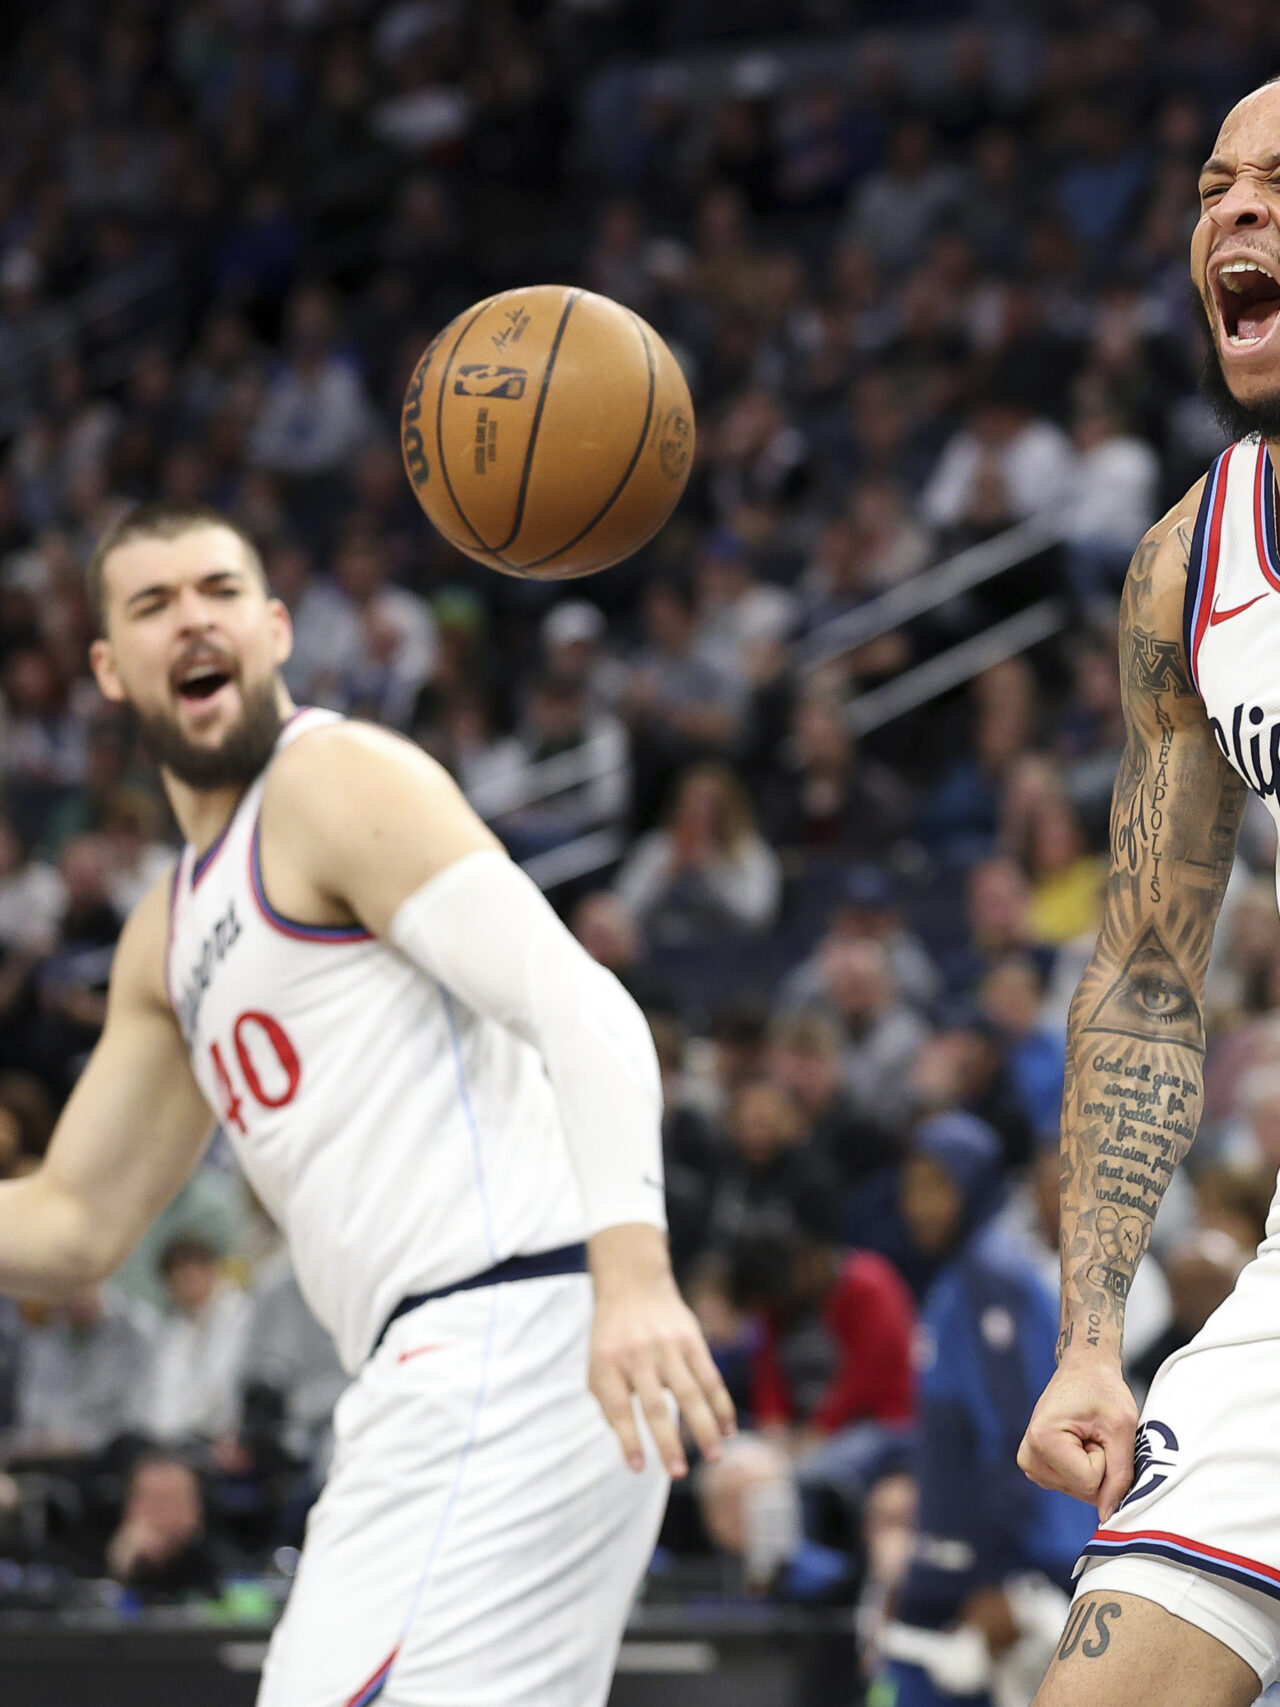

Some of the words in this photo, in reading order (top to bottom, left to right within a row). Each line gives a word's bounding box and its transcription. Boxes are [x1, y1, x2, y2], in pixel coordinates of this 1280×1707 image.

[210, 1010, 302, 1134] 40
[1093, 1055, 1122, 1074] God
[1124, 1064, 1151, 1082] will
[1153, 1072, 1180, 1090] give
[1104, 1083, 1162, 1108] strength
[1167, 1093, 1185, 1115] for
[1116, 1119, 1137, 1142] for
[1140, 1130, 1172, 1157] every
[1097, 1159, 1124, 1180] that
[1087, 1313, 1101, 1346] ATO
